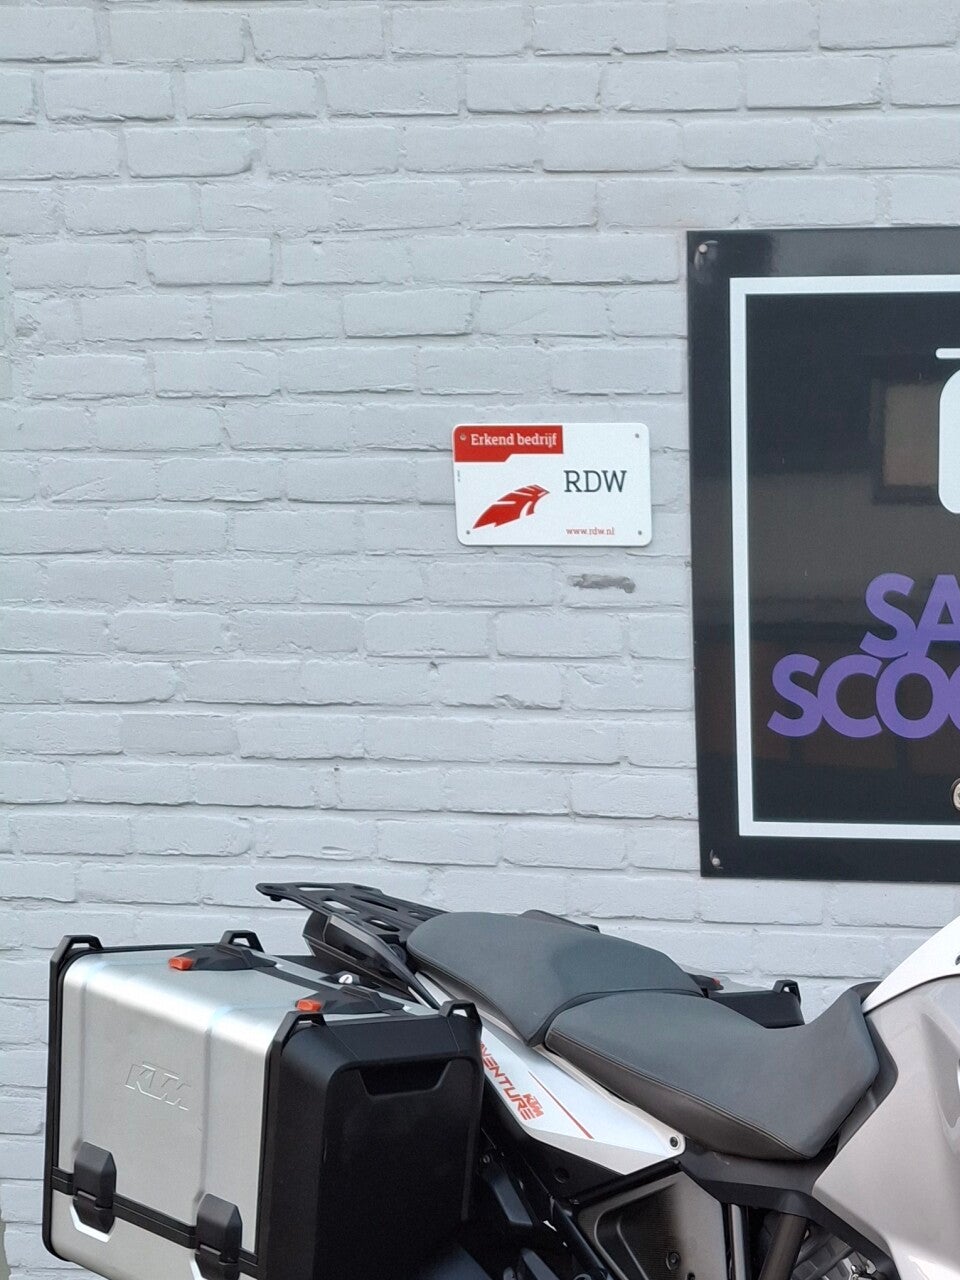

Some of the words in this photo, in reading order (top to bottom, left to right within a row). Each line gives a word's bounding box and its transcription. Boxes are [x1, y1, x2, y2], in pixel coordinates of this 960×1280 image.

[470, 433, 515, 447] Erkend
[516, 432, 558, 448] bedrijf
[563, 470, 627, 493] RDW
[565, 526, 615, 536] www.rdw.nl
